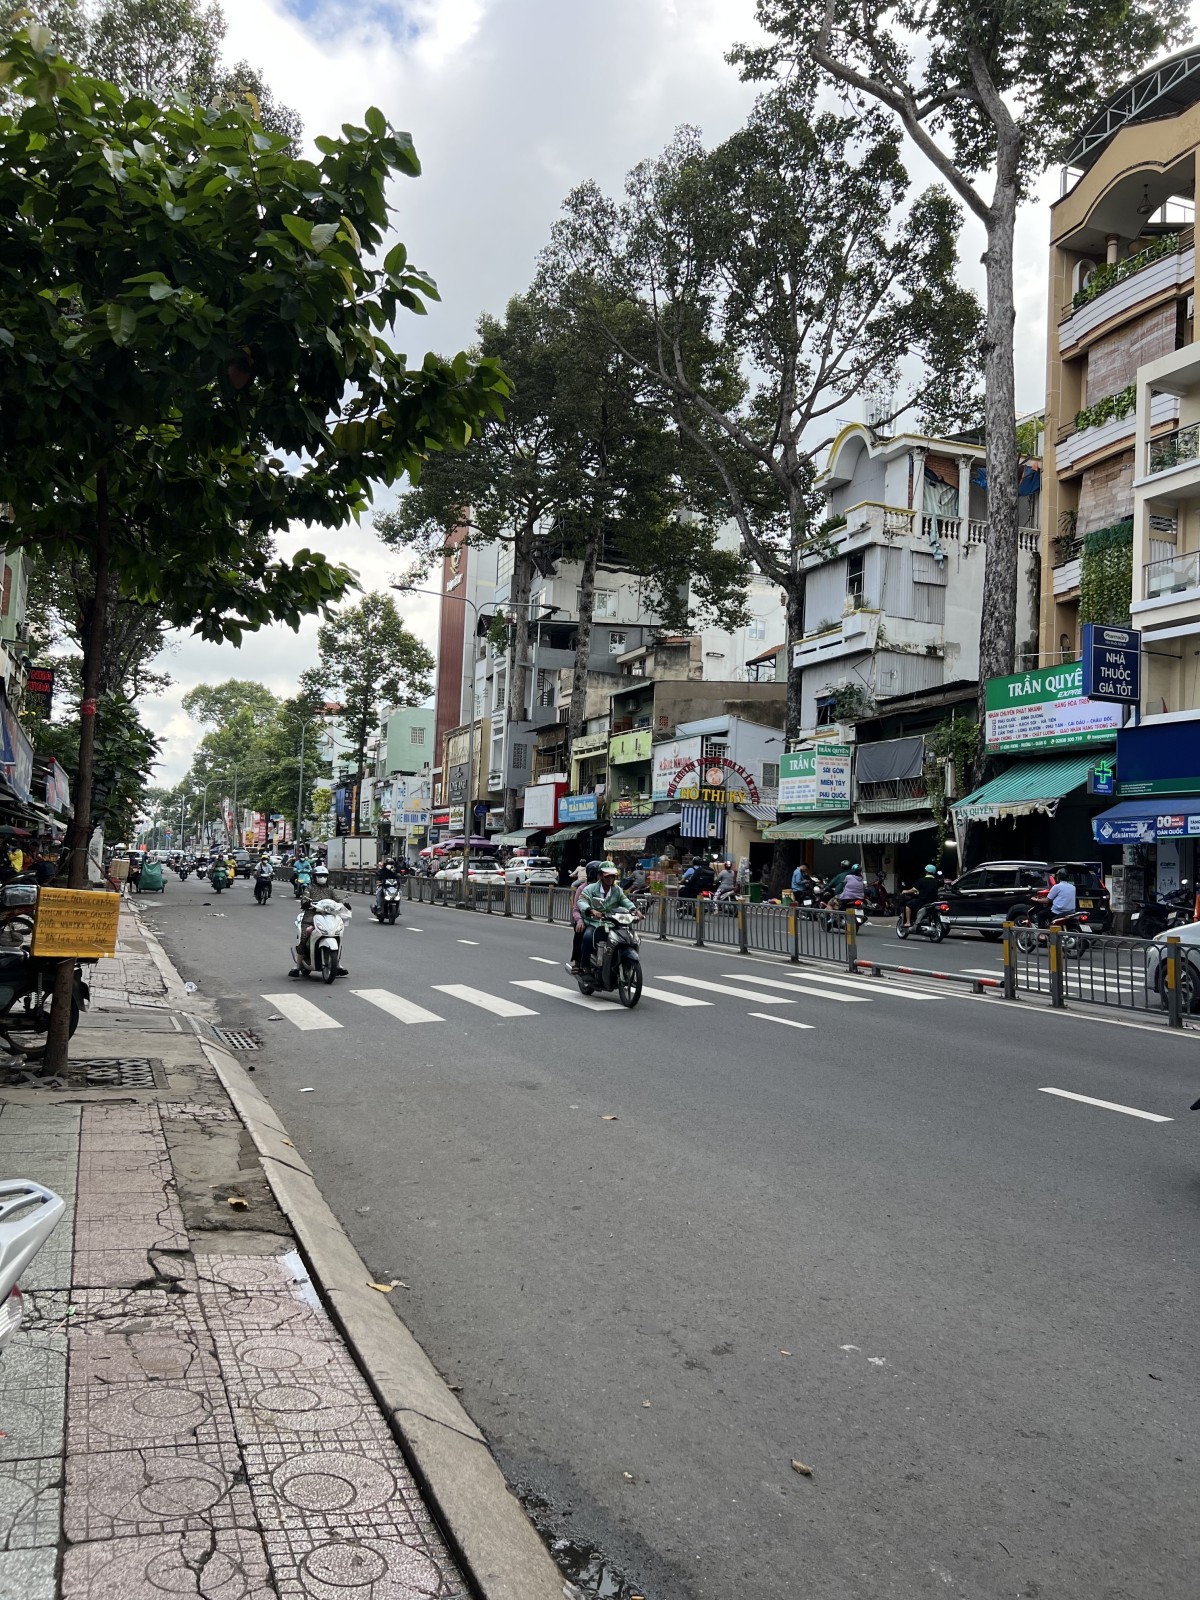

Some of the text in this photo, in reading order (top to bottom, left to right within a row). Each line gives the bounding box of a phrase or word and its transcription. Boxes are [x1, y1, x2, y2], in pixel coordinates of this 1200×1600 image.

[1106, 652, 1125, 665] NHÀ
[1100, 665, 1131, 680] THUỐC
[1008, 675, 1042, 697] TRẦN
[1099, 681, 1132, 696] GIÁ TỐT
[789, 755, 809, 770] TRẦN
[680, 784, 700, 800] HỒ
[702, 789, 726, 804] THỊ
[831, 791, 847, 799] QUỐC
